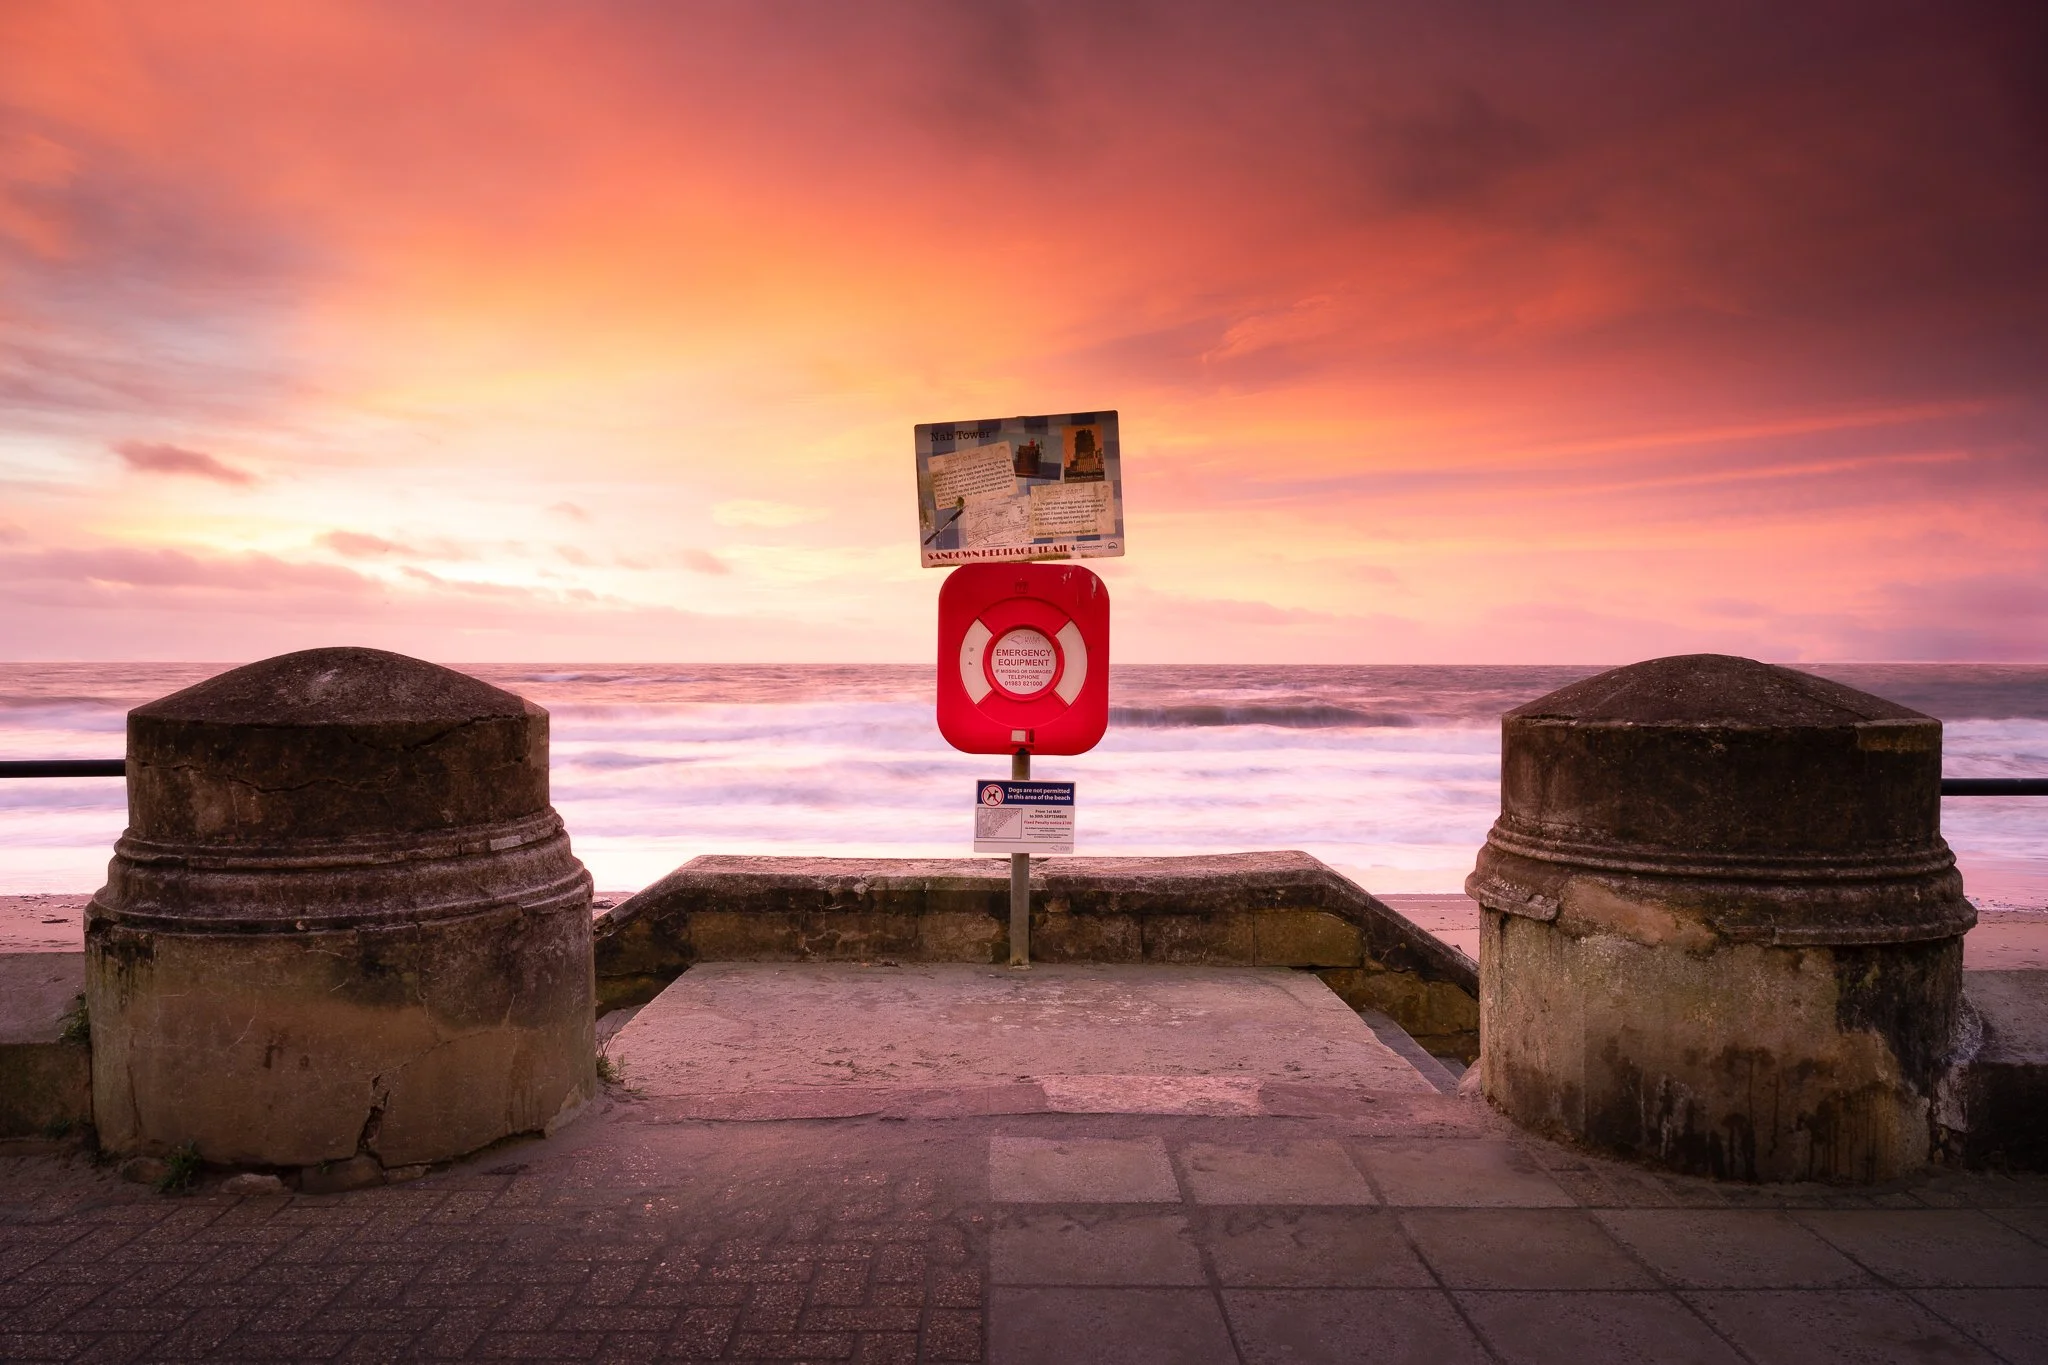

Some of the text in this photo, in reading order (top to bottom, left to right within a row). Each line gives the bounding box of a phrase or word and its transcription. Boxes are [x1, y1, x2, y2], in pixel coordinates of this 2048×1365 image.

[930, 430, 992, 442] Nab Tower
[927, 550, 980, 560] SANDOWN
[981, 546, 1033, 557] HERITAGE
[1038, 544, 1069, 554] TRAIL
